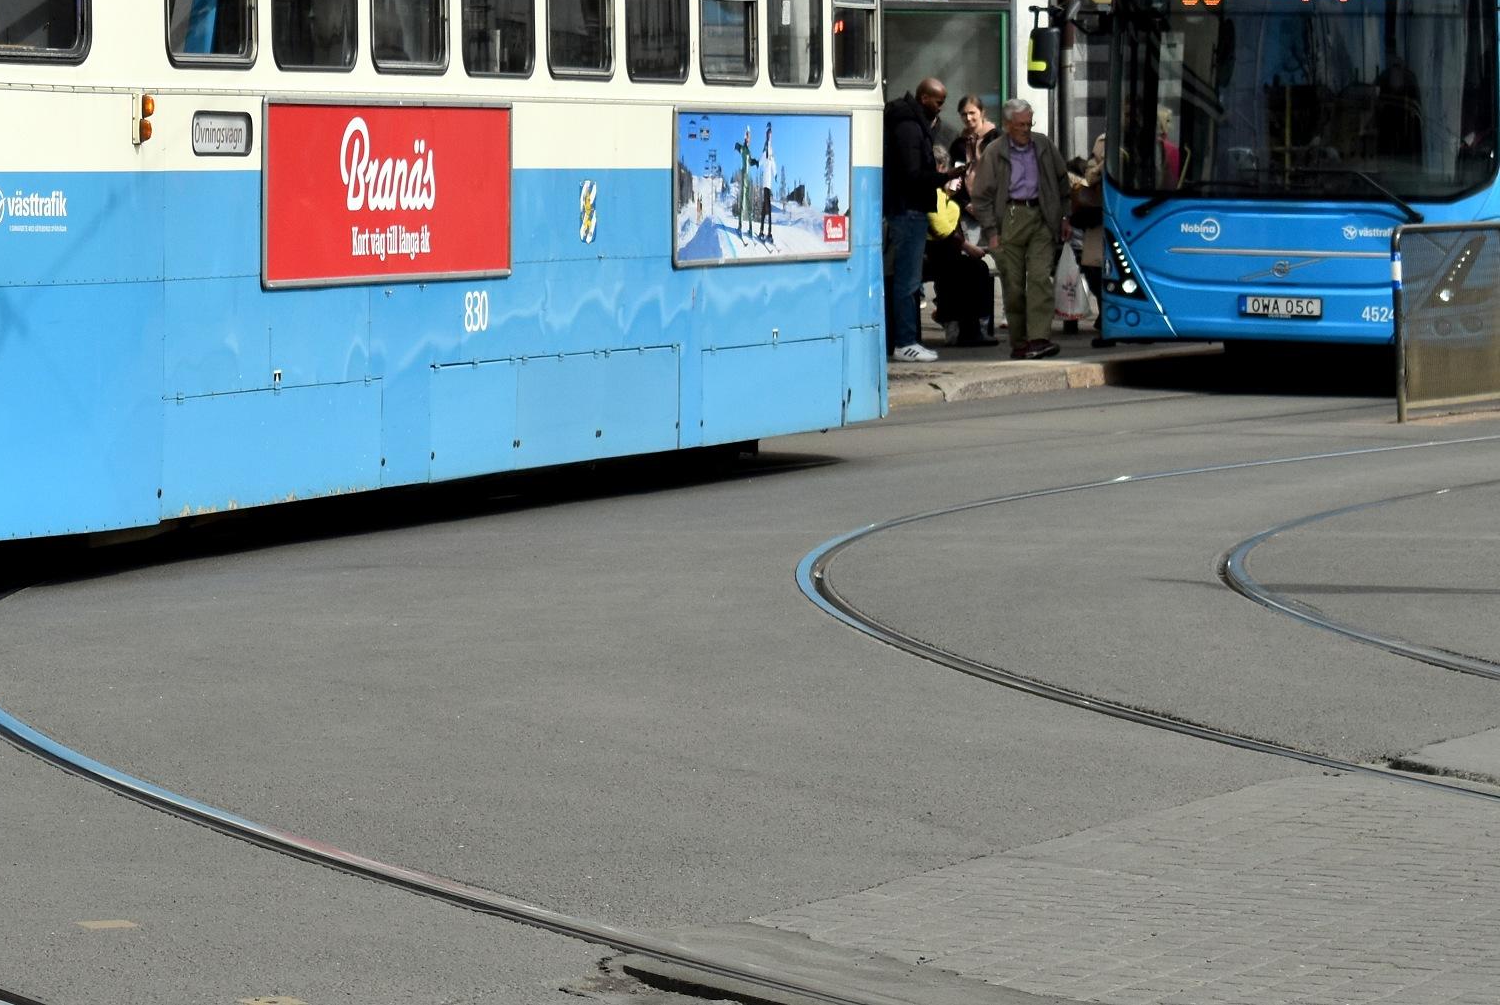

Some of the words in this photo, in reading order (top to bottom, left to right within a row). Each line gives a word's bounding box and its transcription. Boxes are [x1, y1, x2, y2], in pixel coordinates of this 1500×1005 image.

[339, 116, 436, 212] Branäs
[7, 190, 67, 217] västtrafik
[351, 226, 370, 256] Kort
[370, 228, 386, 261] väg
[386, 225, 398, 255] till
[398, 225, 420, 261] långa
[420, 224, 431, 253] åk
[1181, 222, 1216, 234] Nobina
[465, 290, 488, 332] 830
[1251, 298, 1280, 314] OWA
[1285, 299, 1315, 315] 05C
